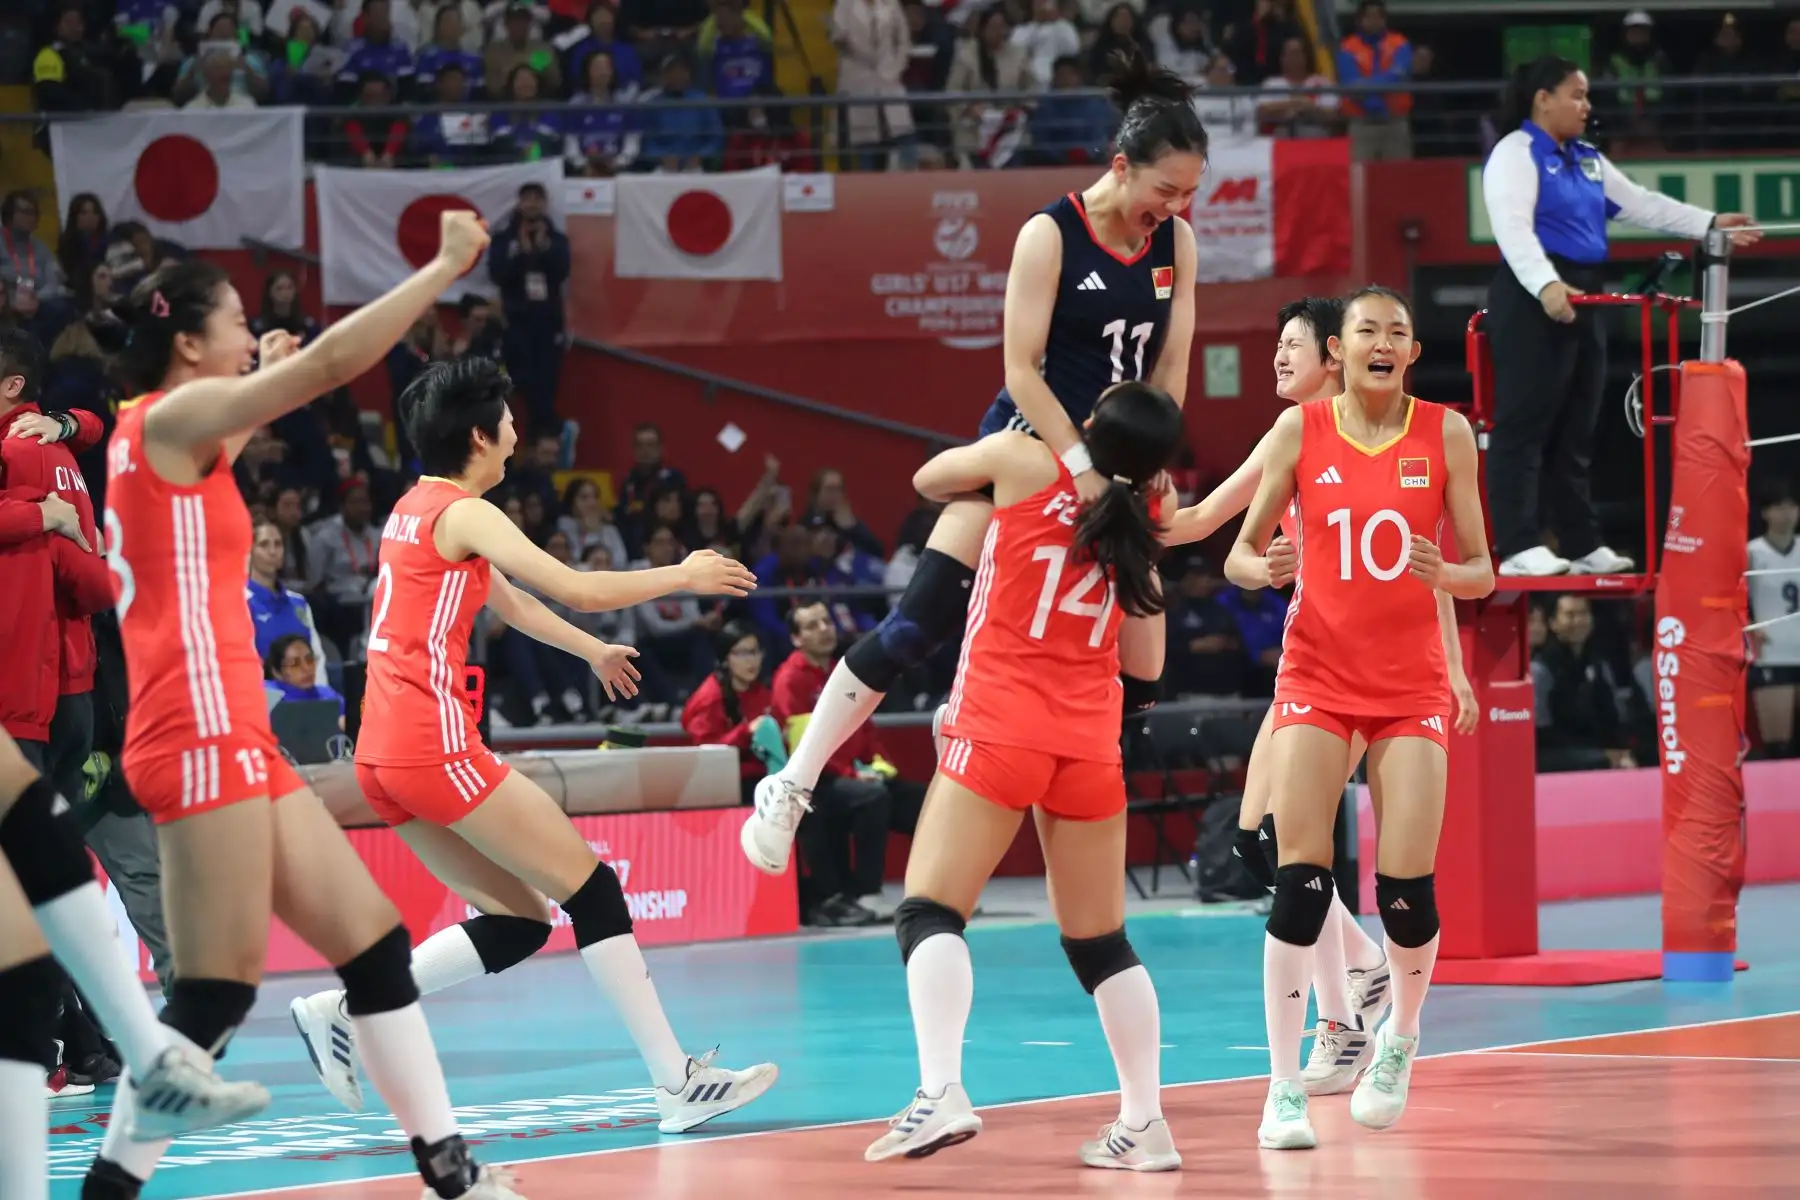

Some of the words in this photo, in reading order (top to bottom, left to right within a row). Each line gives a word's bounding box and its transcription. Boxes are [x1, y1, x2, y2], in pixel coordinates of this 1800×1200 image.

[1404, 478, 1427, 486] CHN
[104, 507, 136, 625] 3
[1327, 508, 1411, 581] 10
[367, 562, 393, 652] 2
[1029, 544, 1117, 648] 14
[1657, 651, 1687, 775] Senoh
[234, 748, 268, 785] 13
